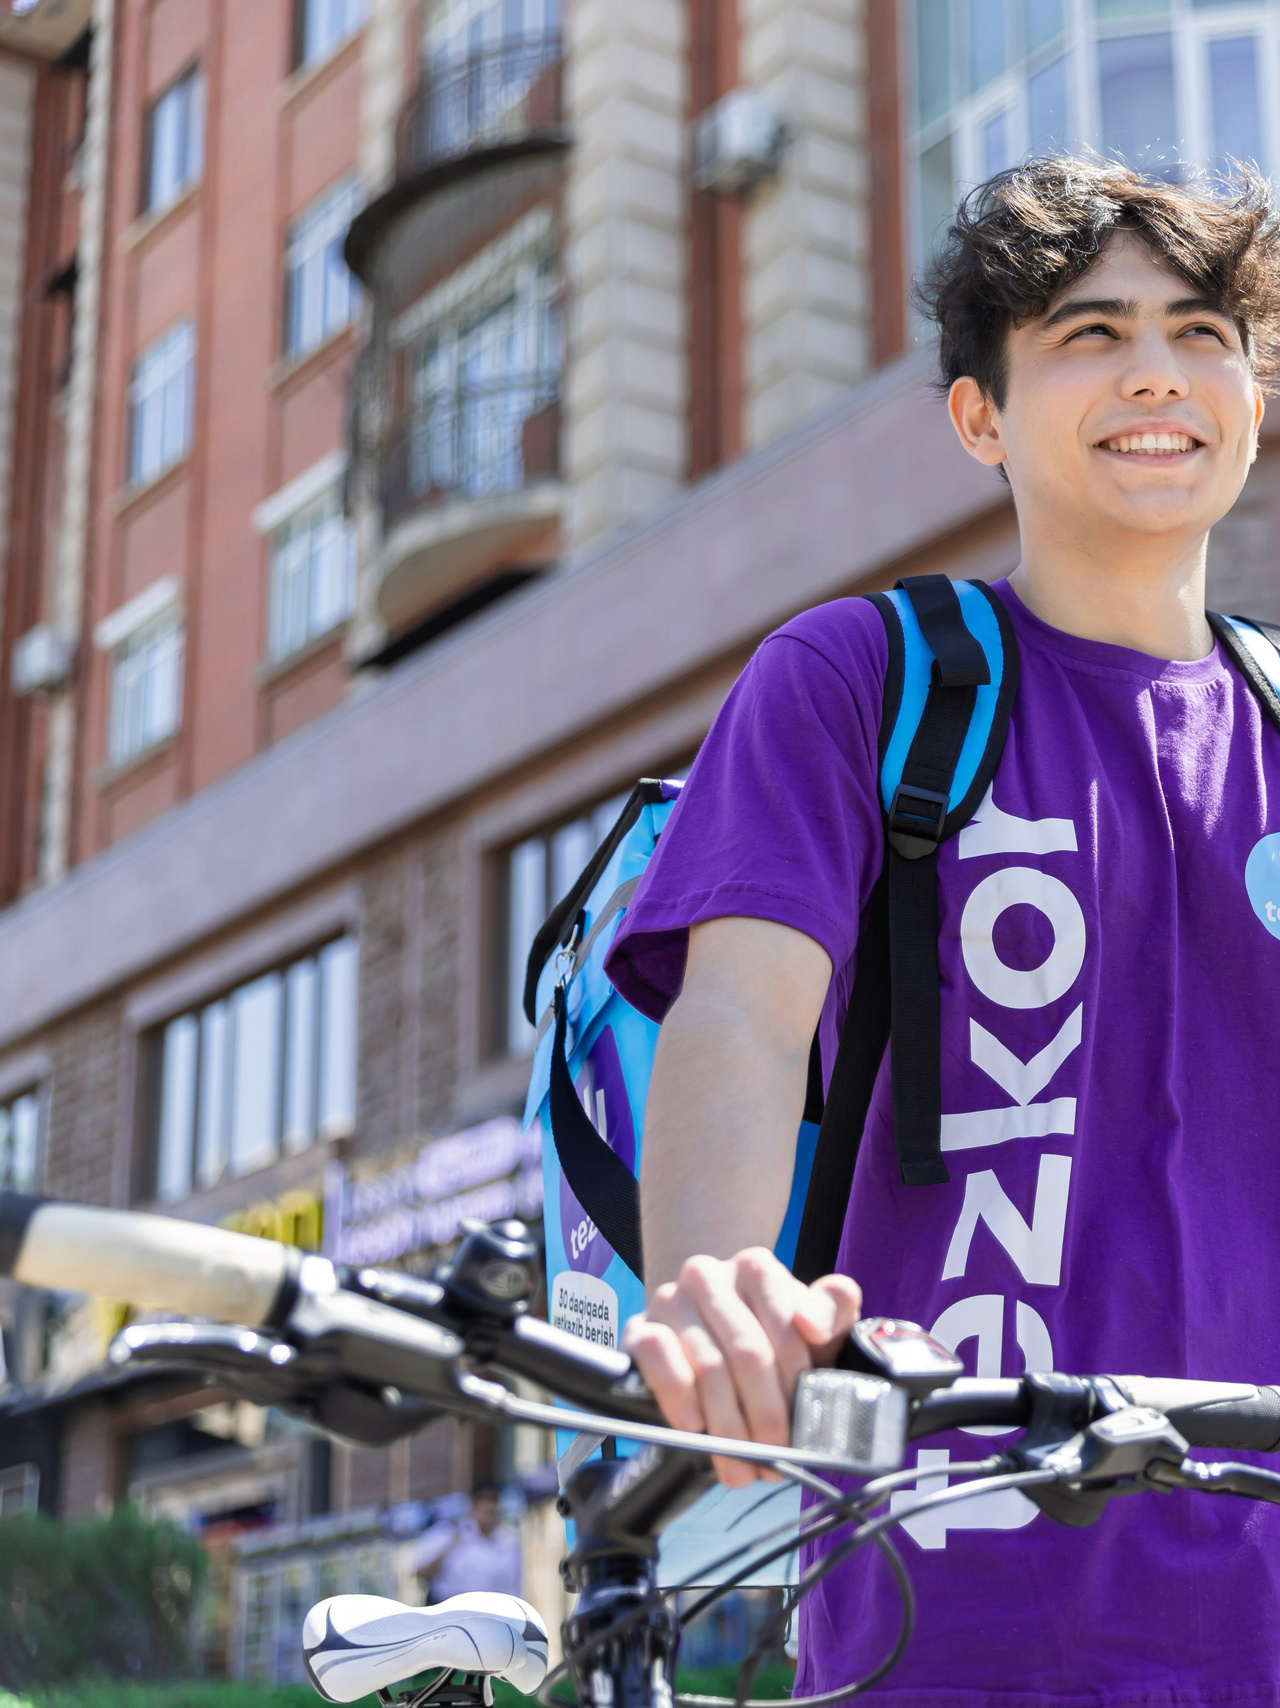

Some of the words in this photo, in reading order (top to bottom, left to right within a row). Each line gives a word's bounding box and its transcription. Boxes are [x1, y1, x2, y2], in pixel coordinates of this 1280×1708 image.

[889, 779, 1086, 1550] tezkor
[570, 1214, 599, 1260] tez
[558, 1287, 568, 1309] 30
[568, 1292, 609, 1322] daqiqada
[585, 1319, 615, 1348] berish
